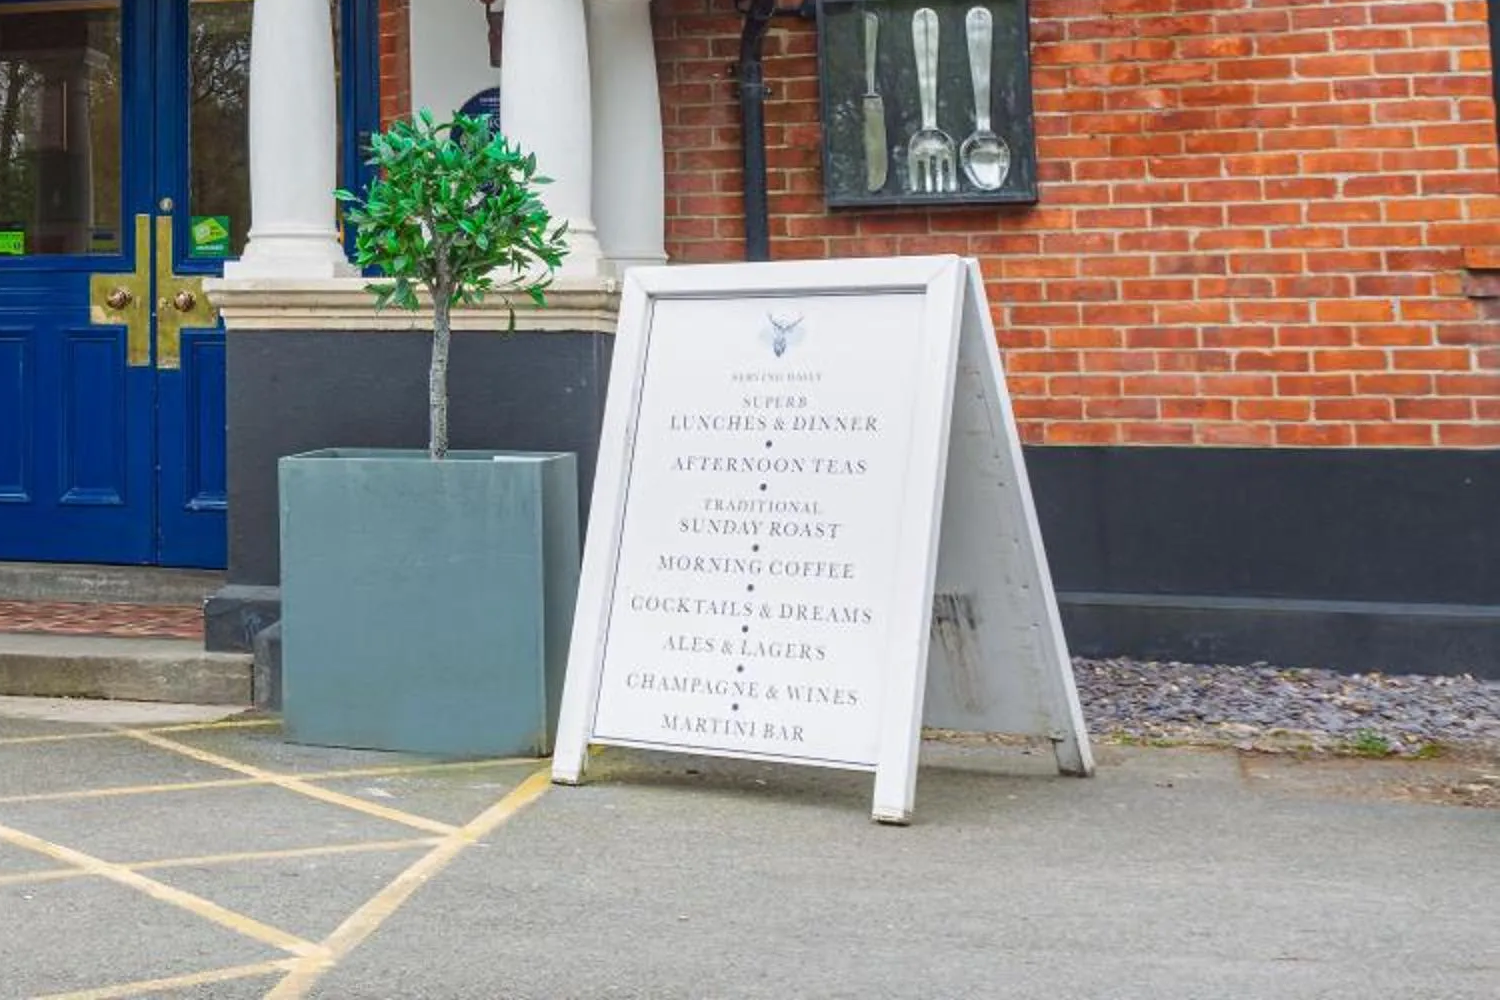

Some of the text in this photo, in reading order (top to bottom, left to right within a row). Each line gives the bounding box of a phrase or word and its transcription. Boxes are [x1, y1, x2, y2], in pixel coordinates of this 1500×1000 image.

[743, 396, 808, 408] SUPERB
[670, 415, 878, 432] LUNCHES & DINNER
[671, 456, 868, 474] AFTERNOON TEAS
[703, 499, 822, 515] TRADITIONAL
[679, 517, 841, 539] SUNDAY ROAST
[658, 555, 855, 579] MORNING COFFEE
[630, 595, 873, 625] COCKTAILS & DREAMS
[663, 635, 826, 661] ALES & LAGERS
[626, 672, 858, 706] CHAMPAGNE & WINES
[661, 713, 804, 742] MARTINI BAR
